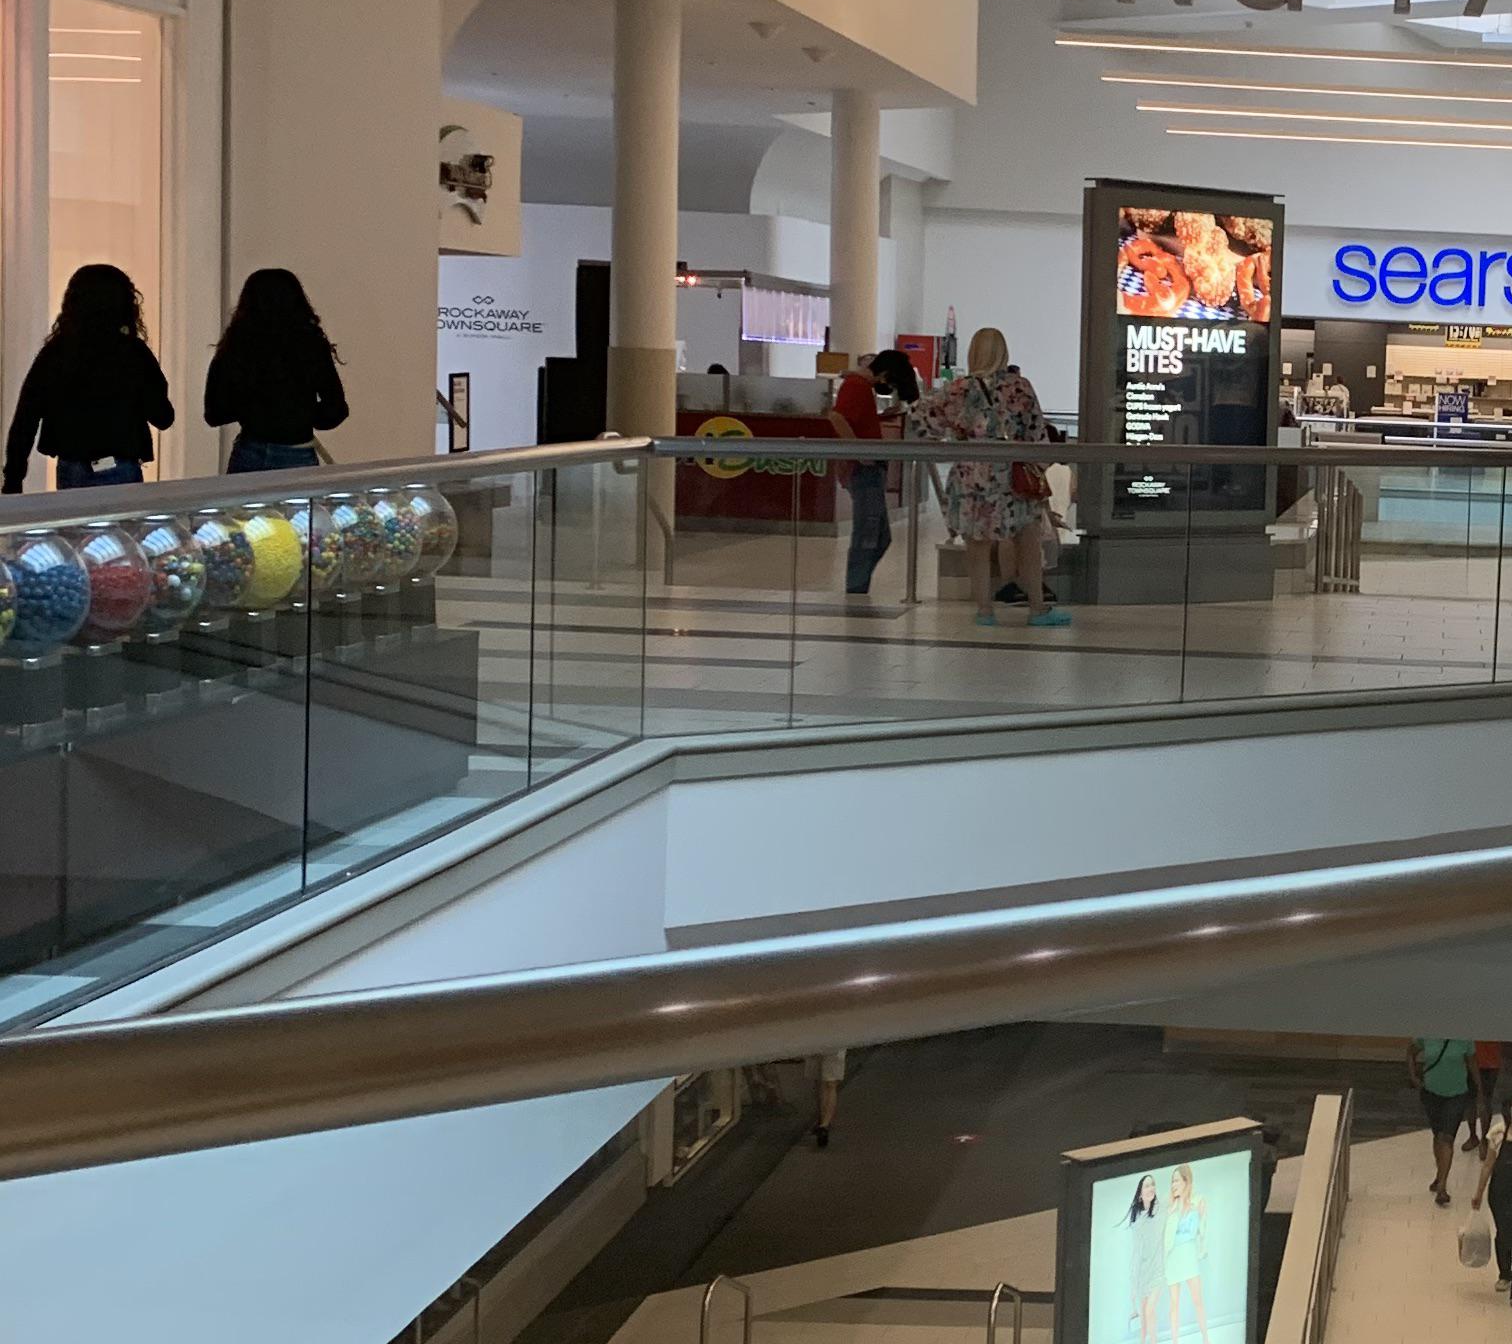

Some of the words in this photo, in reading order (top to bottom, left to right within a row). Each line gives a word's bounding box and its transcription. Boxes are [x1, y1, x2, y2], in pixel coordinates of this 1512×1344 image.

[437, 307, 530, 320] ROCKAWAY
[436, 320, 543, 333] OWNSQUARE
[1127, 324, 1246, 354] MUST-HAVE
[1126, 349, 1183, 374] BITES
[1439, 395, 1467, 406] NOW
